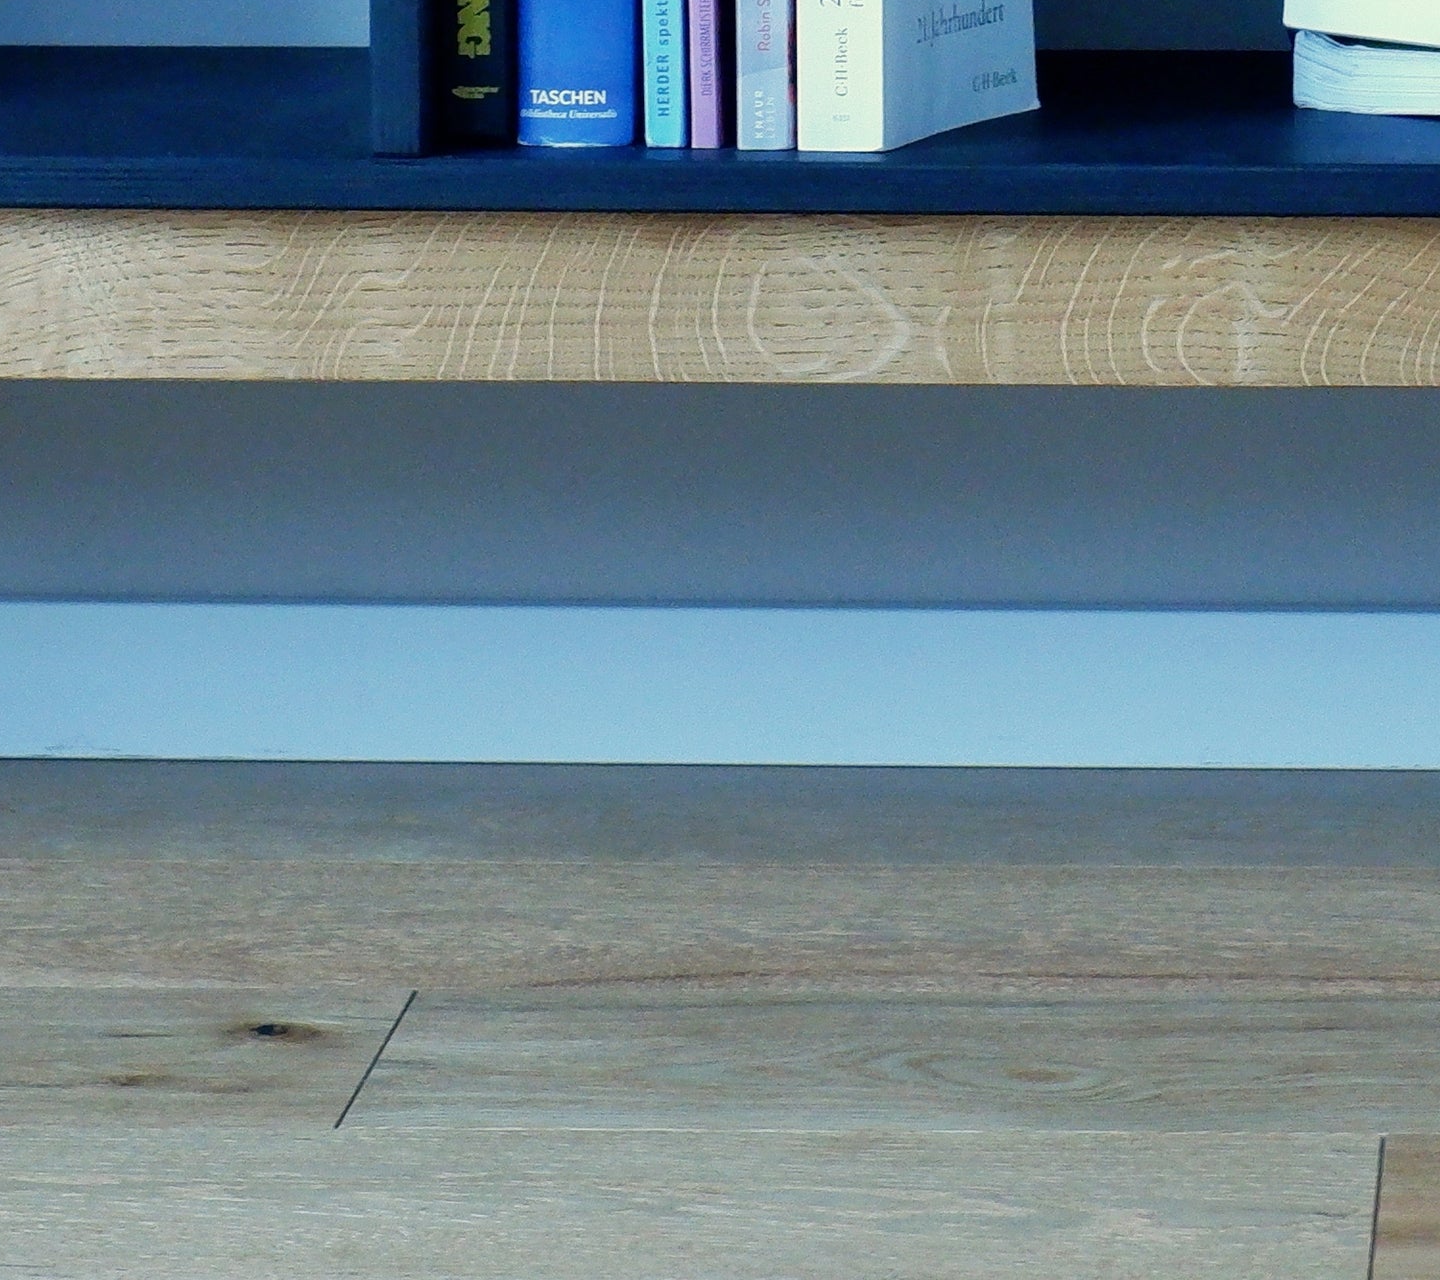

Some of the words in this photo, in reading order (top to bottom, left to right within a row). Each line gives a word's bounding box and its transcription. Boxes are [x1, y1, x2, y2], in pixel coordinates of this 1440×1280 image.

[755, 11, 771, 52] Robin
[529, 89, 607, 105] TASCHEN
[655, 54, 671, 118] HERDER
[753, 89, 764, 139] KNAUR
